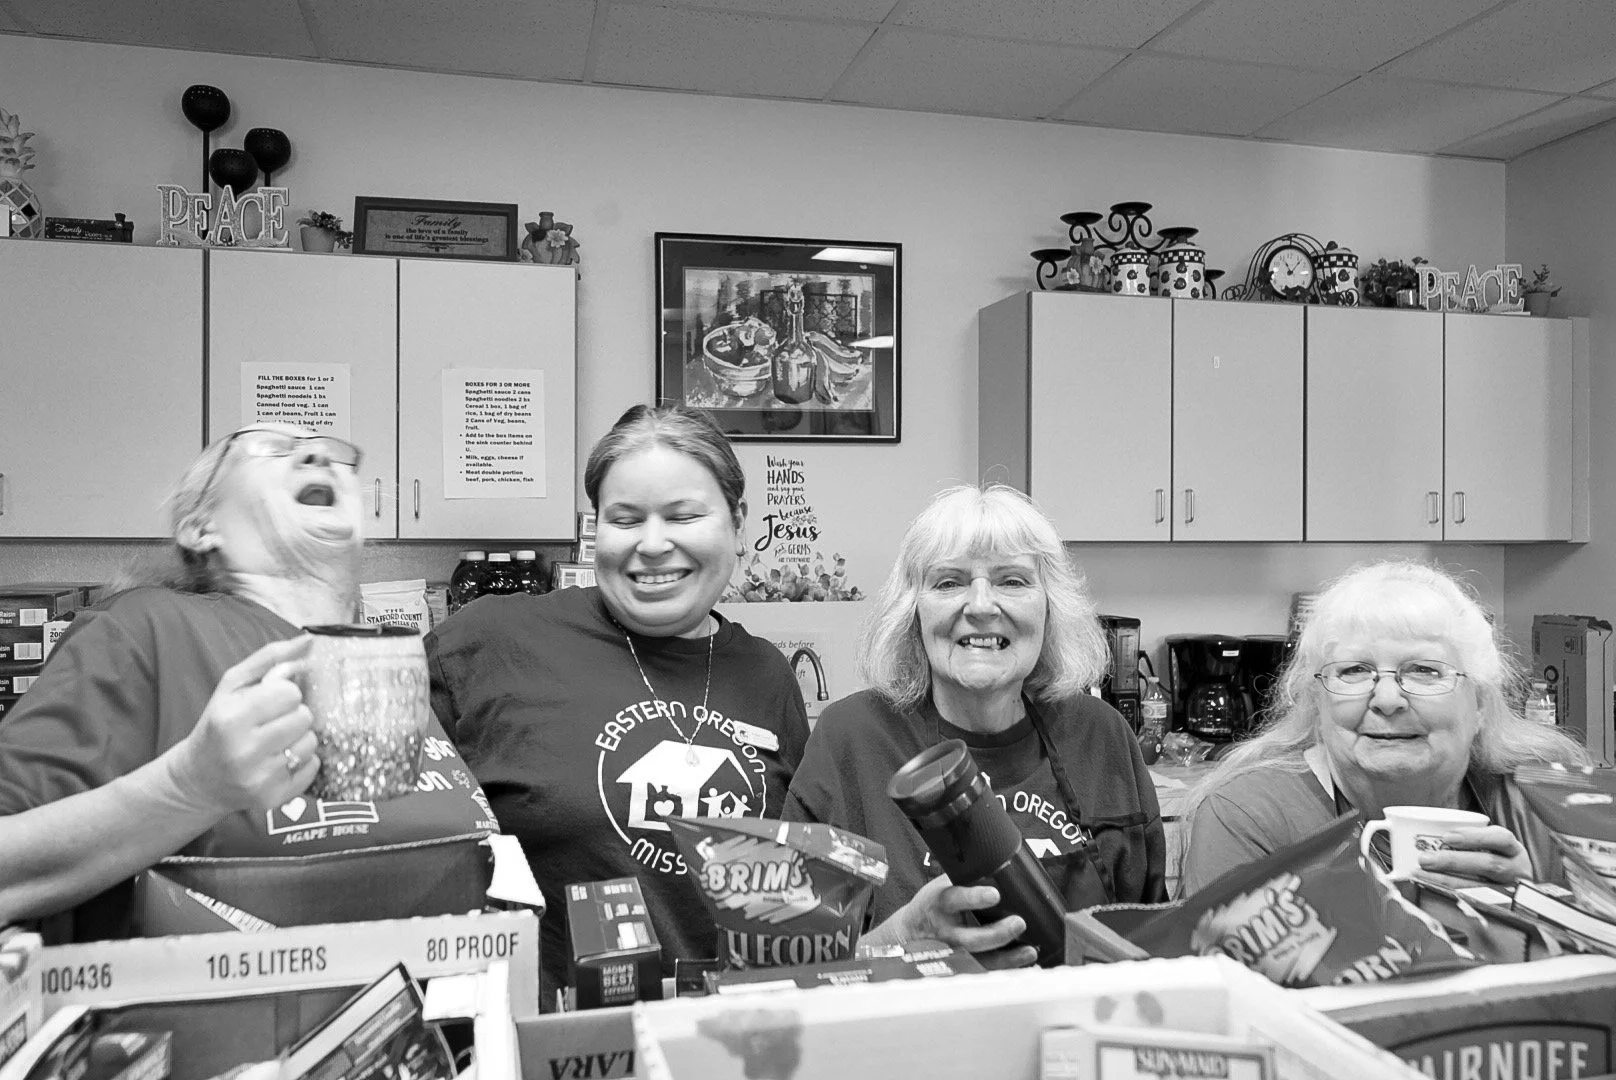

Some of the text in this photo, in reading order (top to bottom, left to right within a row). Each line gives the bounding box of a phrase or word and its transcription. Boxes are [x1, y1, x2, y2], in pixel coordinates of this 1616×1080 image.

[156, 184, 289, 246] PEACE
[411, 215, 461, 229] Family
[1416, 263, 1524, 312] PEACE
[788, 459, 804, 470] your
[767, 468, 805, 484] HANDS
[767, 492, 806, 506] PRAYERS
[778, 506, 813, 520] because
[754, 514, 822, 552] Jesus
[788, 544, 811, 555] GERMS
[366, 613, 400, 625] STAFFORD
[788, 640, 814, 648] before
[282, 824, 370, 845] AGAPE HOUSE
[706, 850, 805, 894] BRIM'S
[206, 952, 250, 980] 10.5
[258, 946, 328, 975] LITERS
[426, 938, 448, 962] 80
[456, 932, 520, 960] PROOF
[602, 964, 634, 976] MOM'S
[603, 974, 634, 988] BEST
